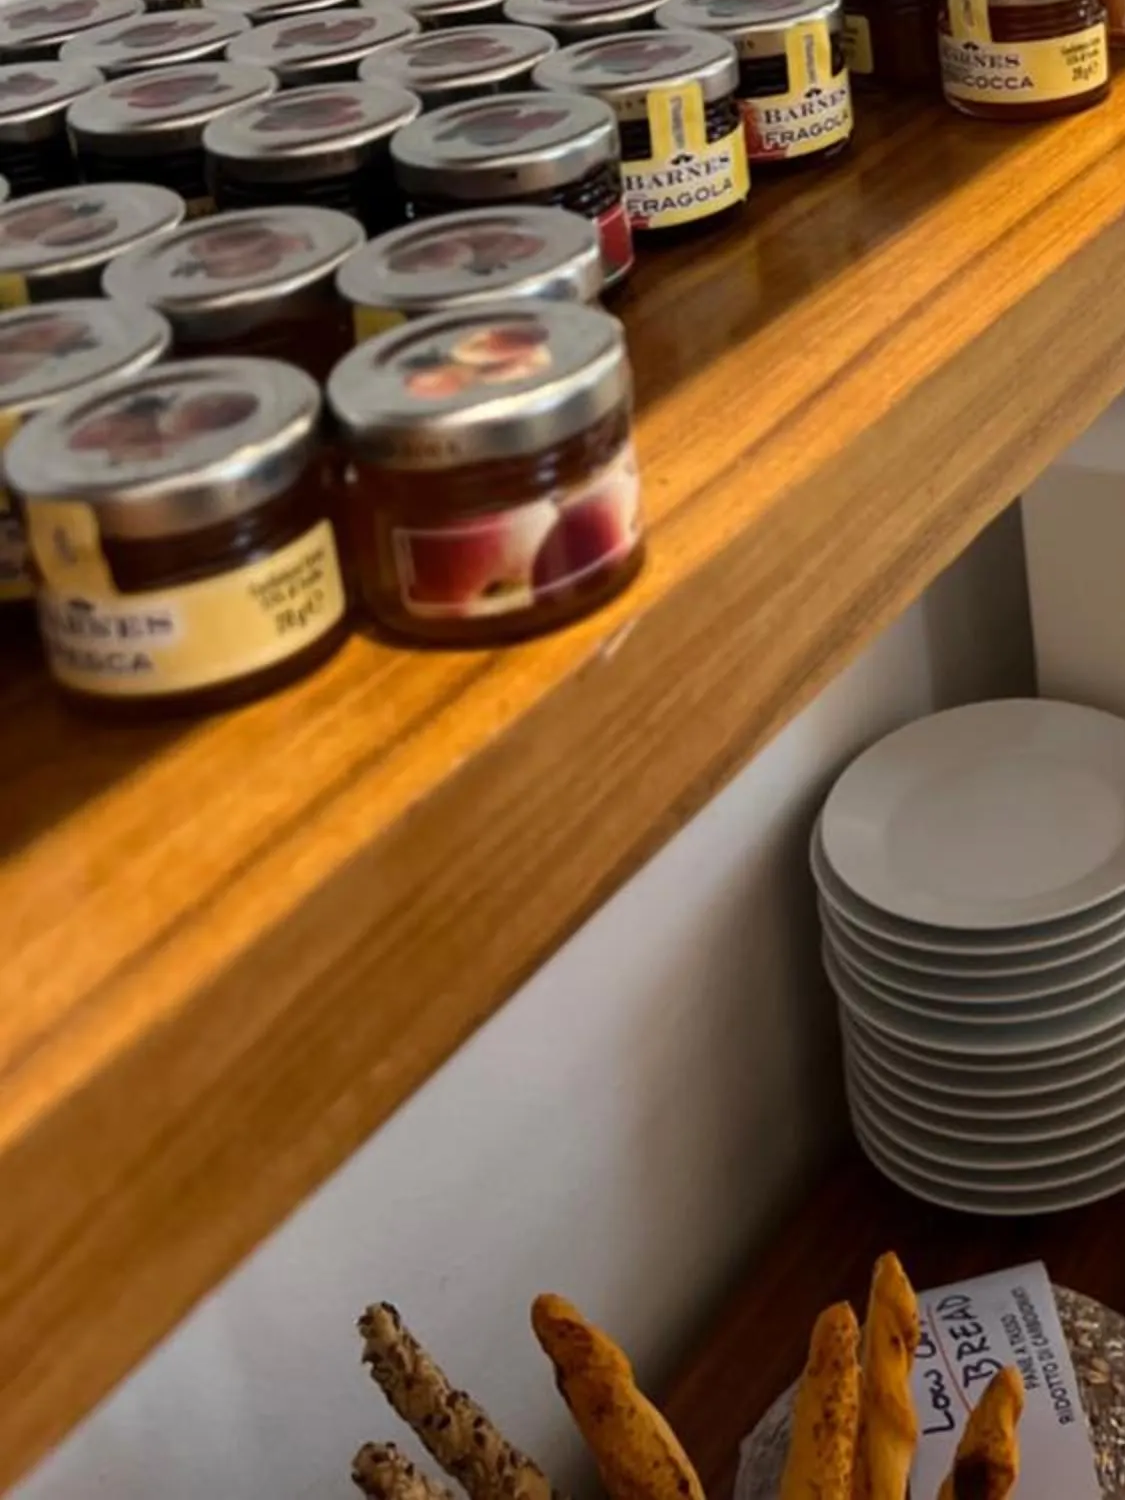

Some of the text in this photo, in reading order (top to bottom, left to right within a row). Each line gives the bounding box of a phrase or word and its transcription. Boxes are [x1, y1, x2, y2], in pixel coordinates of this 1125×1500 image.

[764, 89, 847, 125] BARNES
[764, 109, 849, 147] FRAGOLA
[624, 154, 730, 192] BARNES
[627, 177, 733, 214] FRAGOLA
[936, 1293, 1004, 1389] BREAD
[1041, 1360, 1075, 1426] RIDOTTO
